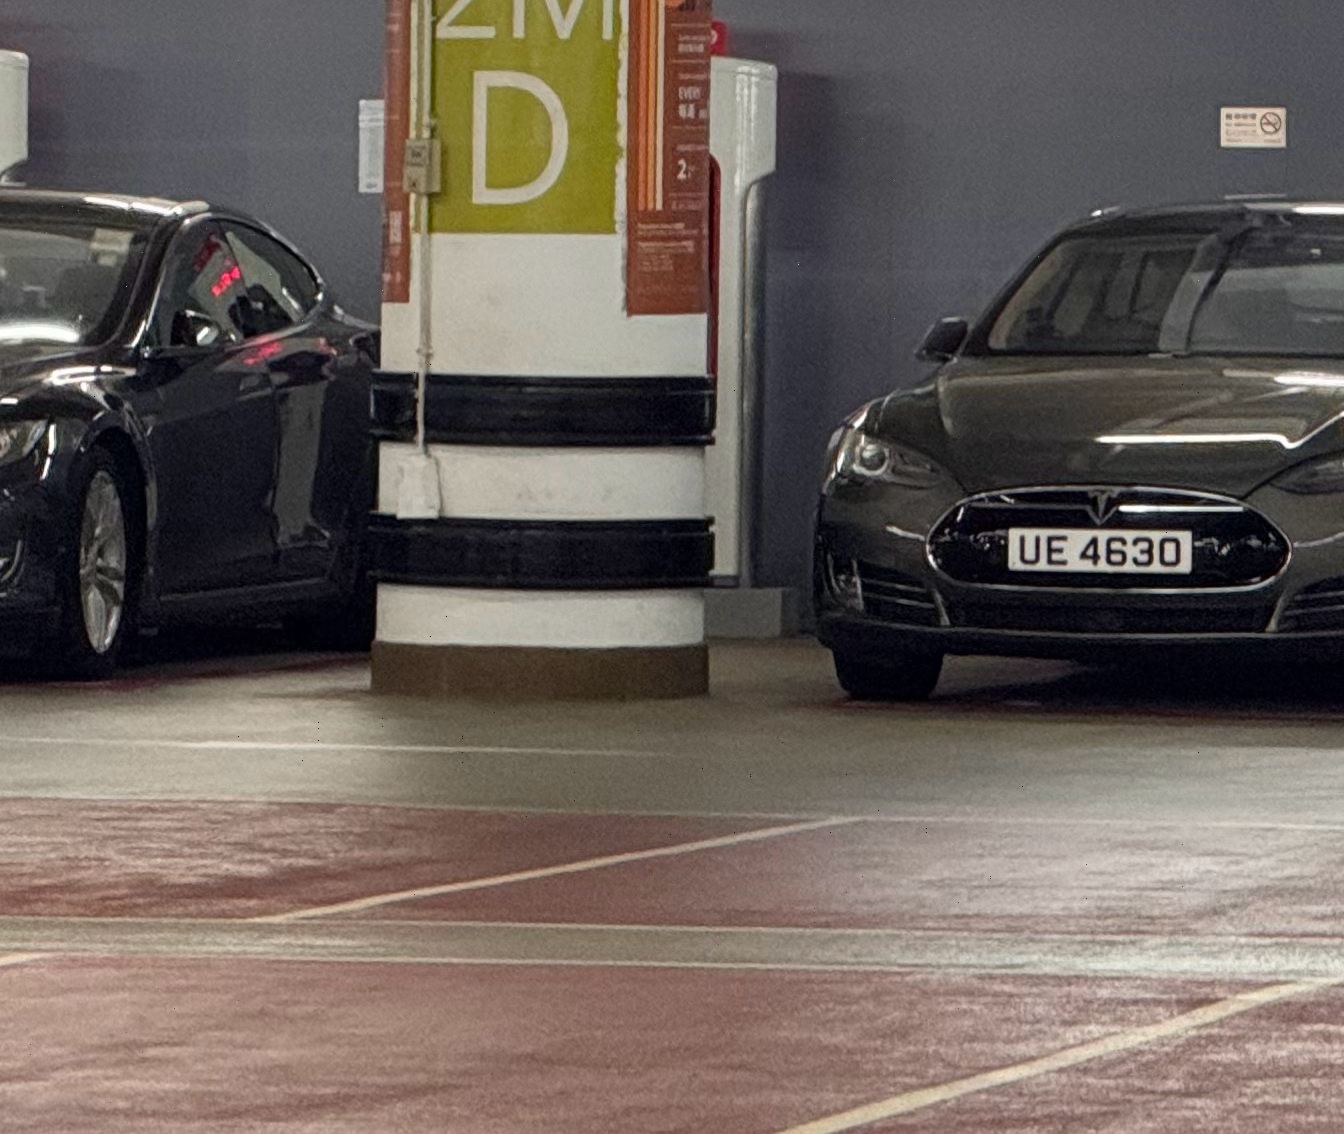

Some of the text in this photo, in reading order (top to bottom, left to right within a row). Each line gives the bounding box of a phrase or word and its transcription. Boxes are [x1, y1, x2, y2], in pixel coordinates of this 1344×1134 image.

[472, 70, 569, 205] D
[1019, 535, 1182, 567] UE 4630
